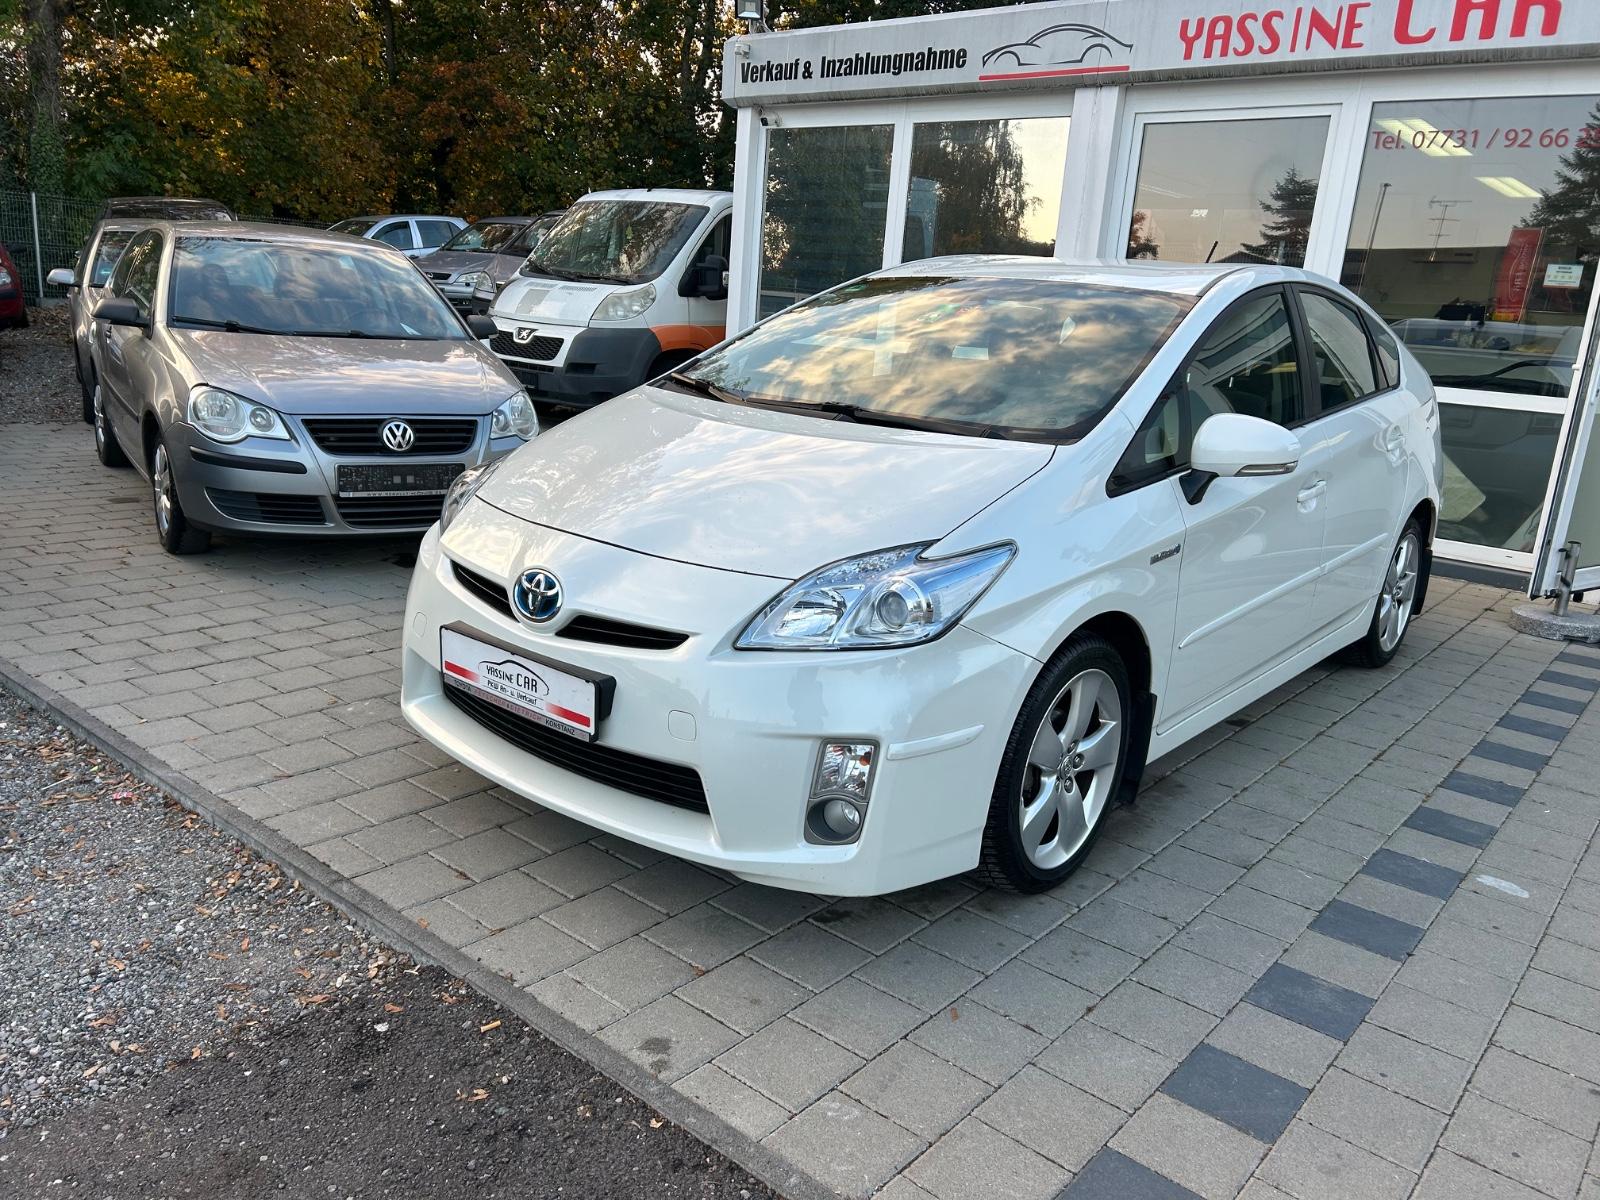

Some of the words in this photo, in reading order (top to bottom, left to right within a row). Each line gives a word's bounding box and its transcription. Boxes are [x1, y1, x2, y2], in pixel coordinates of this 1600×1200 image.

[1178, 2, 1371, 60] YASSINE
[741, 58, 800, 83] Verkauf
[802, 60, 813, 80] &
[820, 47, 968, 78] Inzahlungnahme
[1372, 131, 1405, 150] Tel.
[1412, 129, 1480, 150] 07731
[1504, 128, 1534, 149] 92
[1539, 127, 1570, 149] 66
[486, 665, 514, 684] YASSINE
[517, 673, 538, 693] CAR
[516, 691, 538, 706] Verkauf
[545, 718, 576, 736] KONSTANZ
